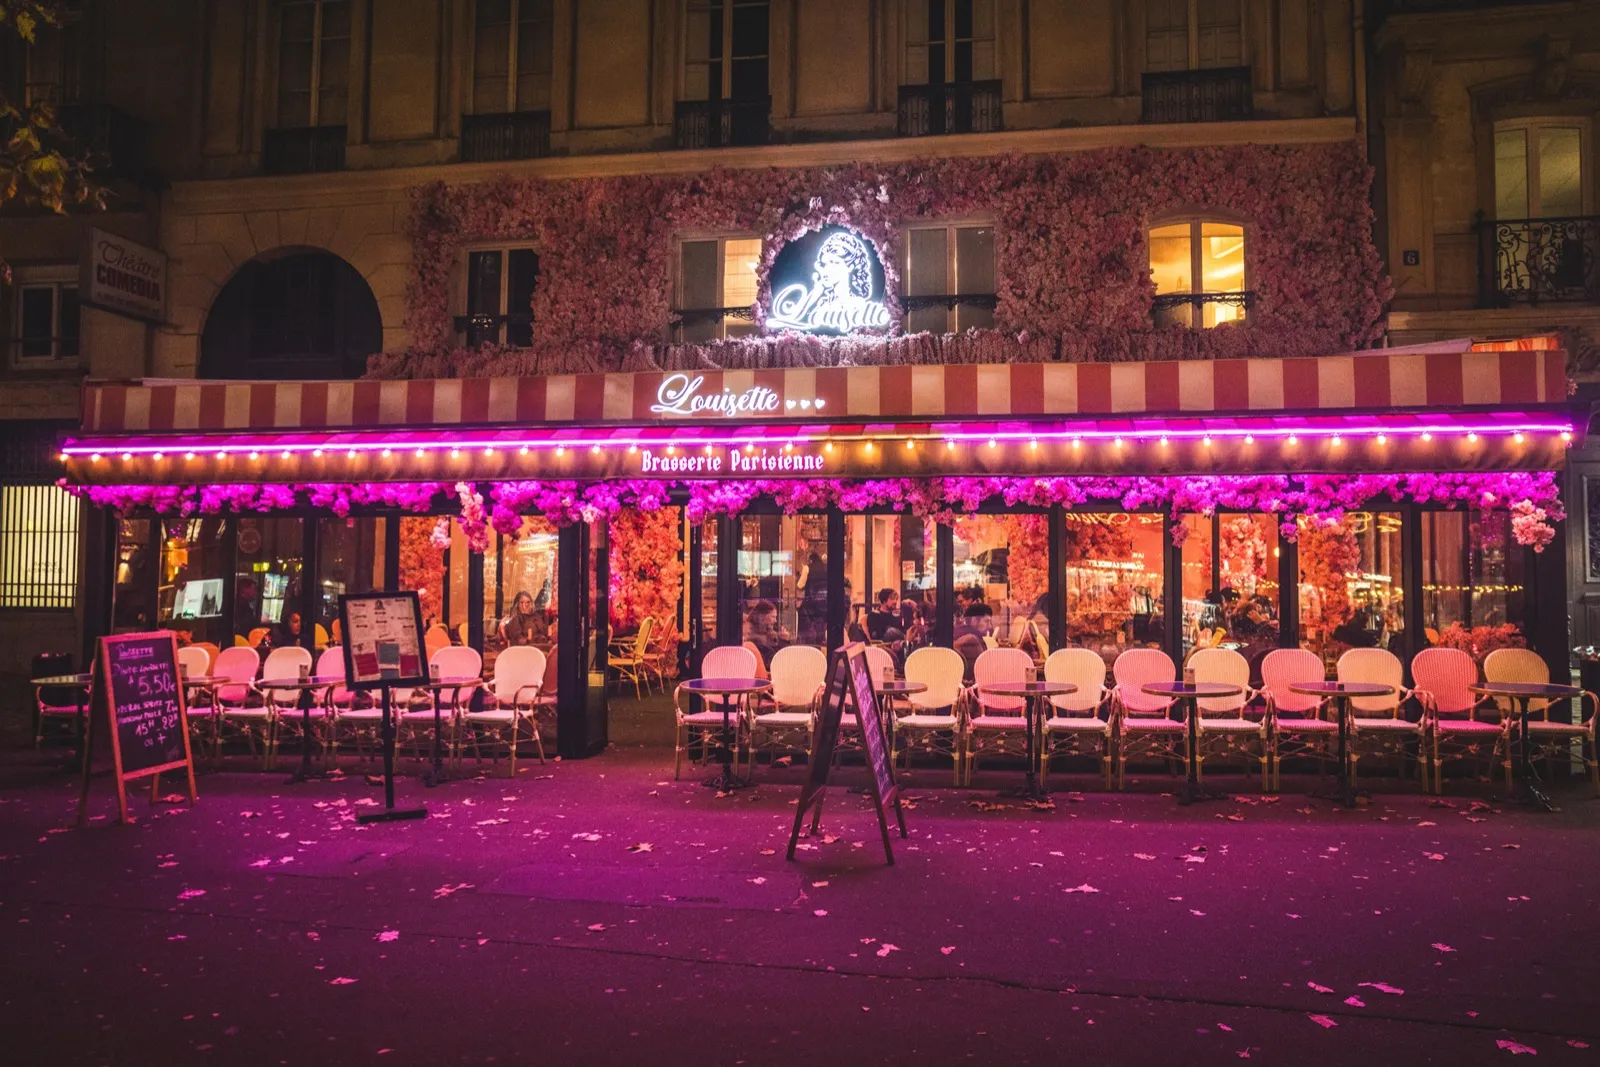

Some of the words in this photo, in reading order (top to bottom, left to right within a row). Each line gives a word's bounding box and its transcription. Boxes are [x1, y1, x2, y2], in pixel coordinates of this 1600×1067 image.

[1407, 251, 1416, 265] 6
[765, 283, 892, 332] Louisette
[650, 374, 780, 416] Louisette
[641, 449, 722, 472] Brasserie
[730, 448, 825, 472] Parisienne
